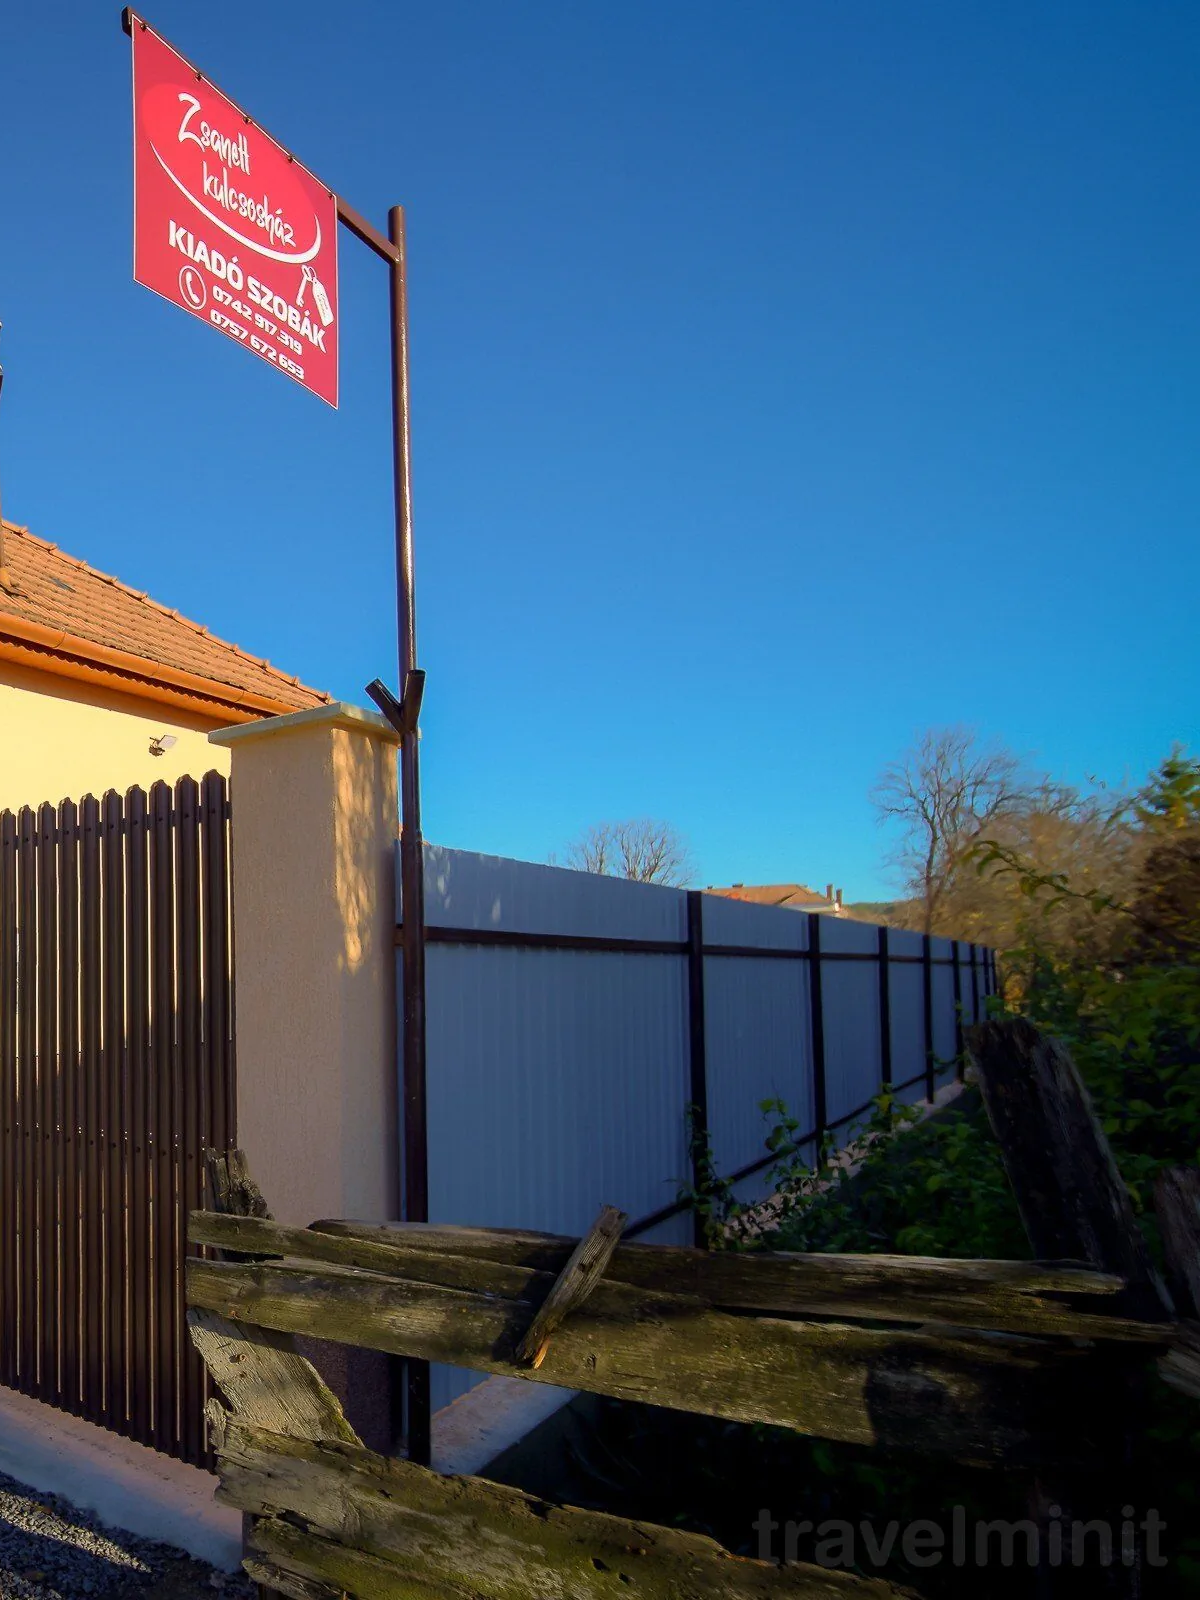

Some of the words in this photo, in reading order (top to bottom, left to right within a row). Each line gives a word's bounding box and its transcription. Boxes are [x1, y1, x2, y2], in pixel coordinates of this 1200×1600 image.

[178, 92, 251, 175] Zsanett
[202, 161, 296, 247] kulcsosház
[168, 219, 244, 291] KIADÓ
[247, 275, 327, 354] SZOBÁK
[212, 285, 253, 321] 0742
[254, 312, 278, 336] 917
[276, 329, 303, 356] 319
[210, 308, 249, 341] 0757
[250, 333, 277, 362] 672
[278, 353, 305, 380] 653
